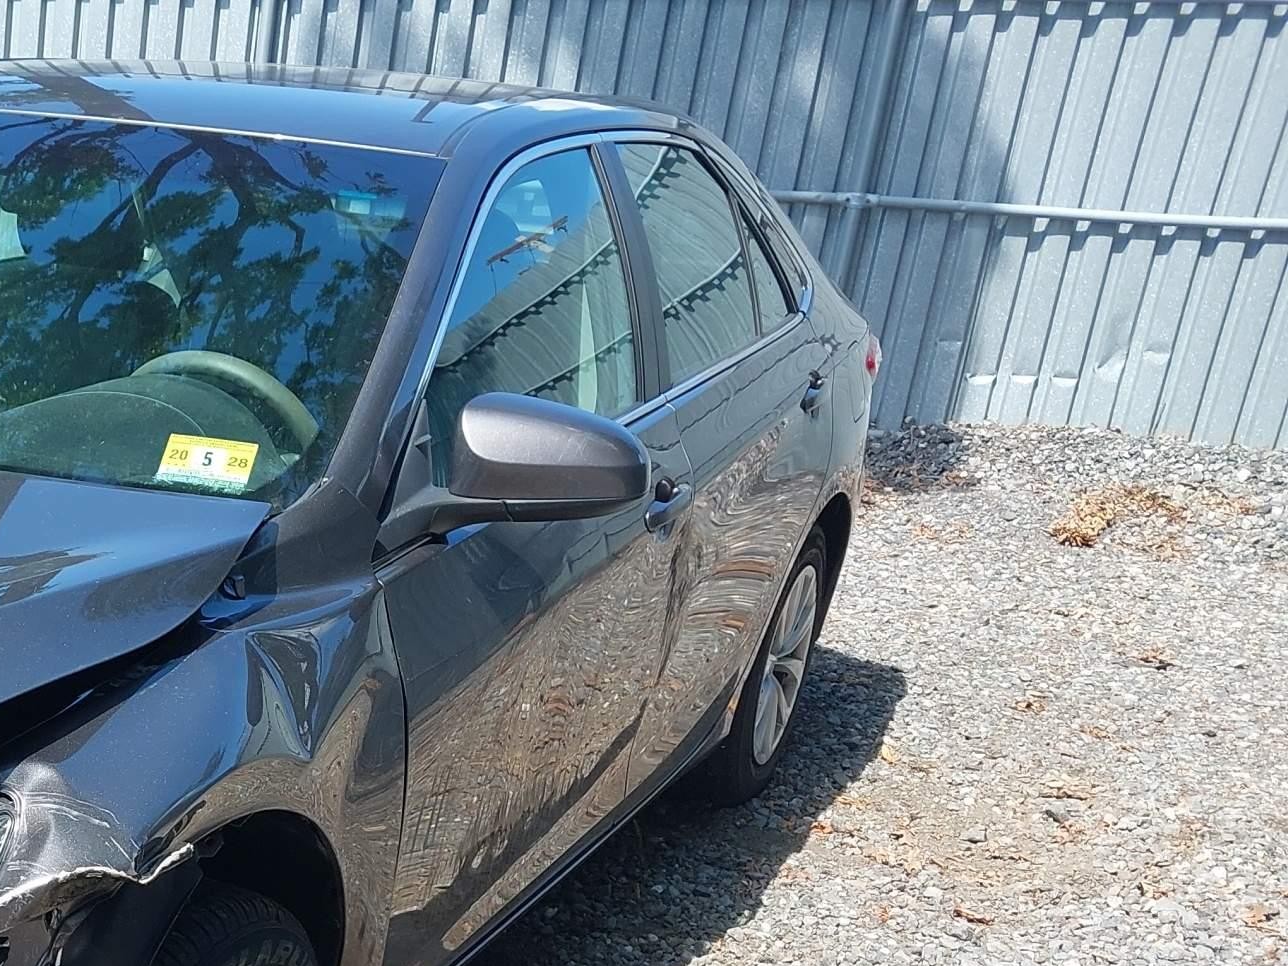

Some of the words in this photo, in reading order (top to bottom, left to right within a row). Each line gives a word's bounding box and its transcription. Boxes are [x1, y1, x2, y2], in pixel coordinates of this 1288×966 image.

[169, 448, 189, 461] 20
[202, 451, 214, 467] 5
[227, 456, 249, 469] 28
